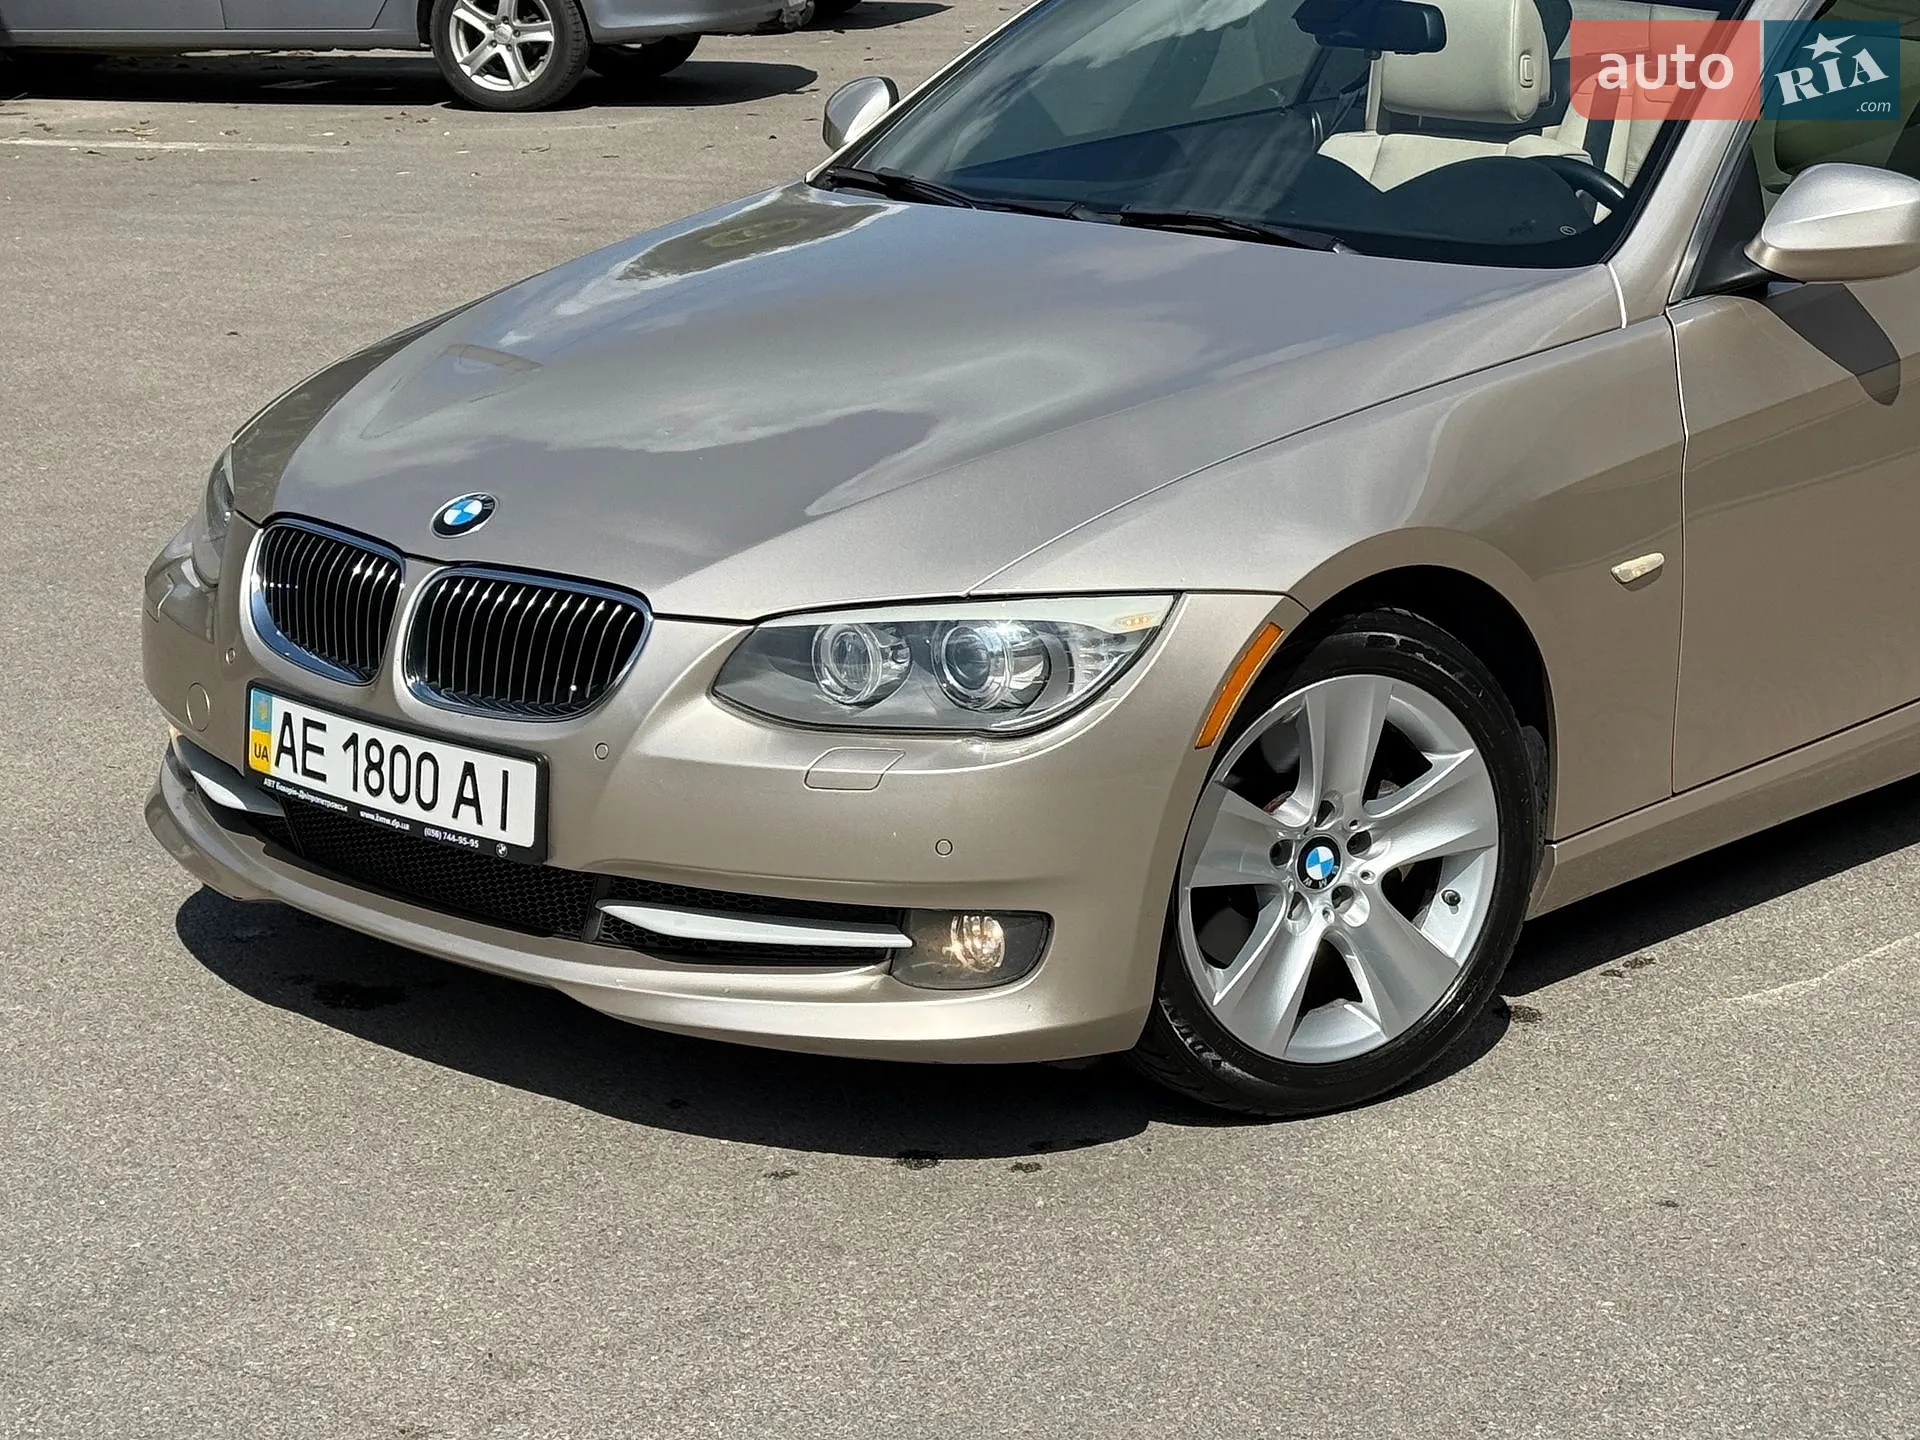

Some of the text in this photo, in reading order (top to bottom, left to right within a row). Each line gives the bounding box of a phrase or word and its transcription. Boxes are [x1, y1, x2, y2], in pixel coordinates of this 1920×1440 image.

[254, 743, 269, 761] UA
[275, 711, 509, 832] AE 1800 AI
